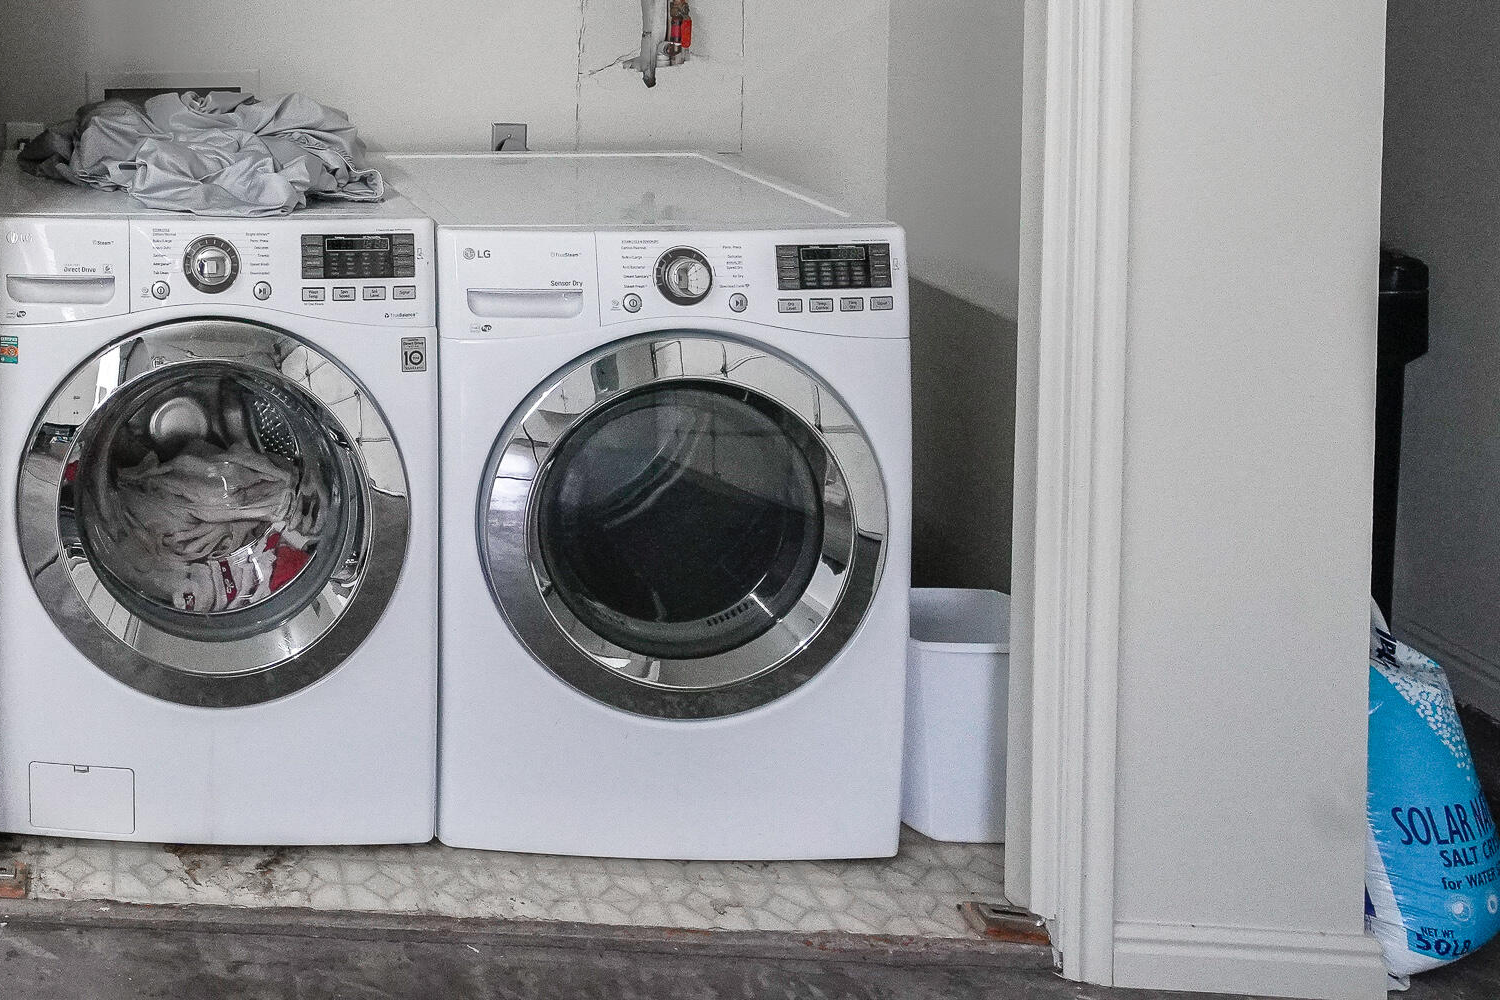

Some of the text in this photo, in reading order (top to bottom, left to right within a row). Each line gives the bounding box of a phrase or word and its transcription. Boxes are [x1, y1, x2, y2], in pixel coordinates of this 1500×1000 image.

[477, 250, 491, 258] LG
[1391, 803, 1476, 846] SOLAR
[1439, 845, 1478, 868] SALT
[1441, 876, 1463, 890] for
[1466, 866, 1497, 889] WATER
[1420, 926, 1454, 939] NET WT
